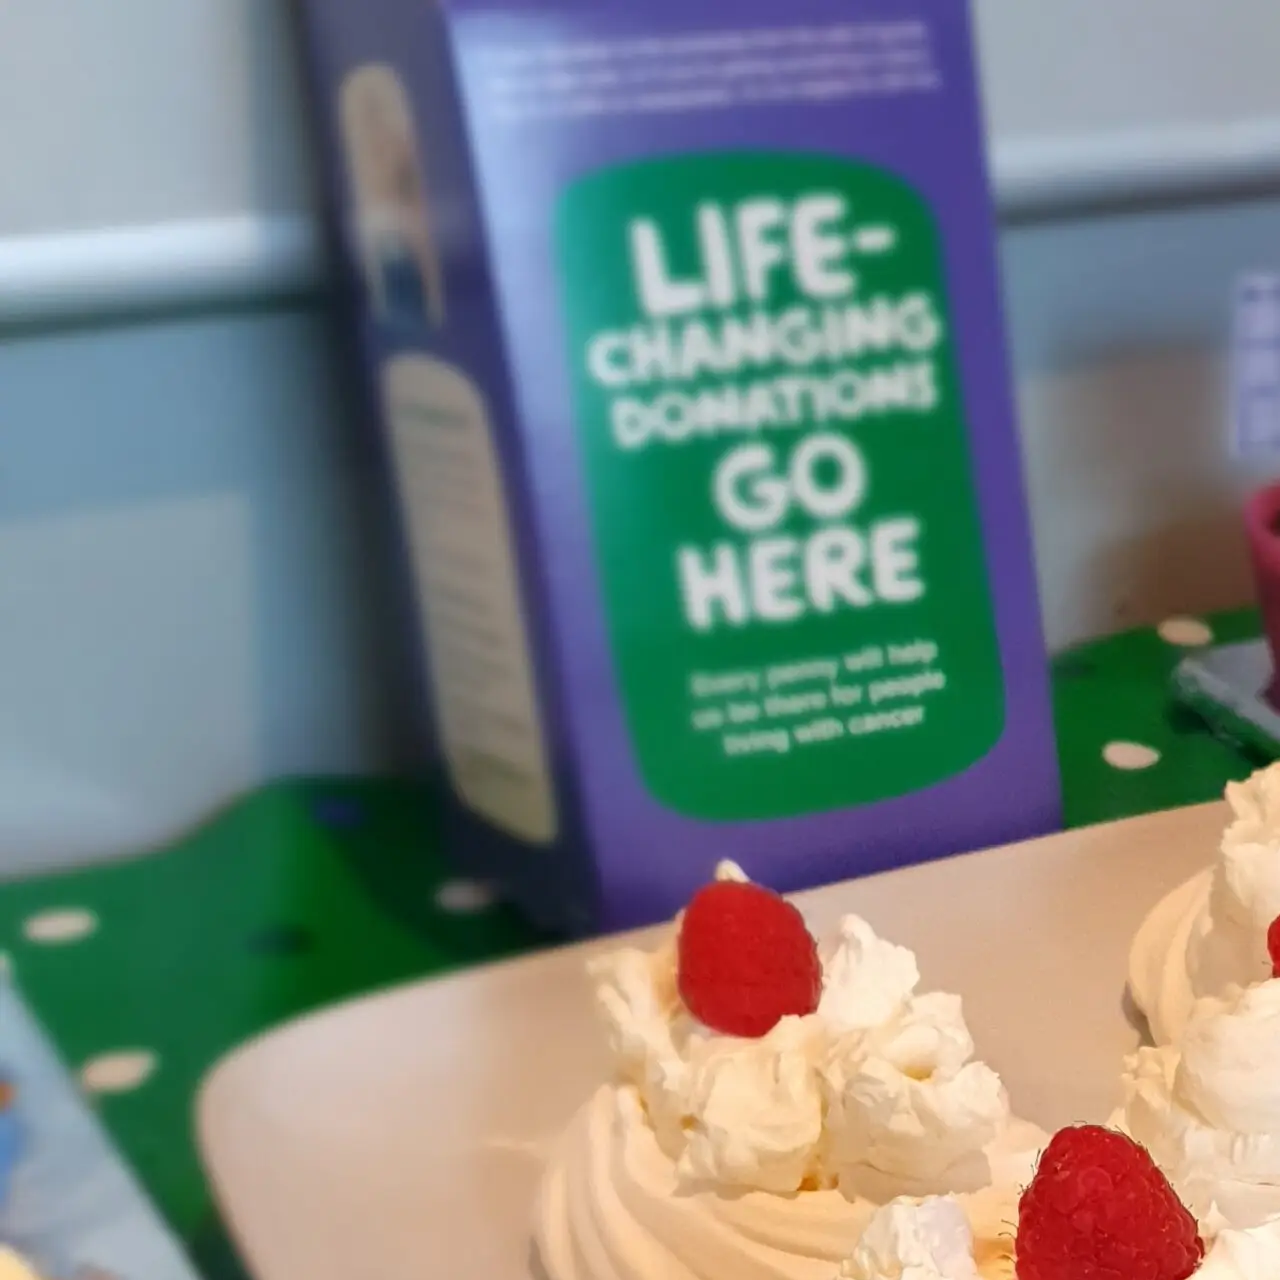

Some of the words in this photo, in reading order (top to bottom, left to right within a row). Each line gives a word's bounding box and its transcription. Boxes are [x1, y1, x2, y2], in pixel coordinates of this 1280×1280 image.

[628, 192, 895, 316] LIFE-
[587, 292, 940, 386] CHANGING
[610, 360, 938, 447] DONATIONS
[712, 432, 867, 530] GO
[677, 517, 925, 630] HERE
[690, 670, 760, 698] Every
[767, 659, 838, 691] penny
[844, 645, 884, 671] will
[887, 640, 939, 666] help
[727, 700, 761, 724] be
[763, 690, 827, 717] there
[831, 682, 863, 707] for
[868, 669, 946, 704] people
[723, 726, 790, 756] living
[793, 716, 844, 744] with
[847, 705, 925, 735] cancer
